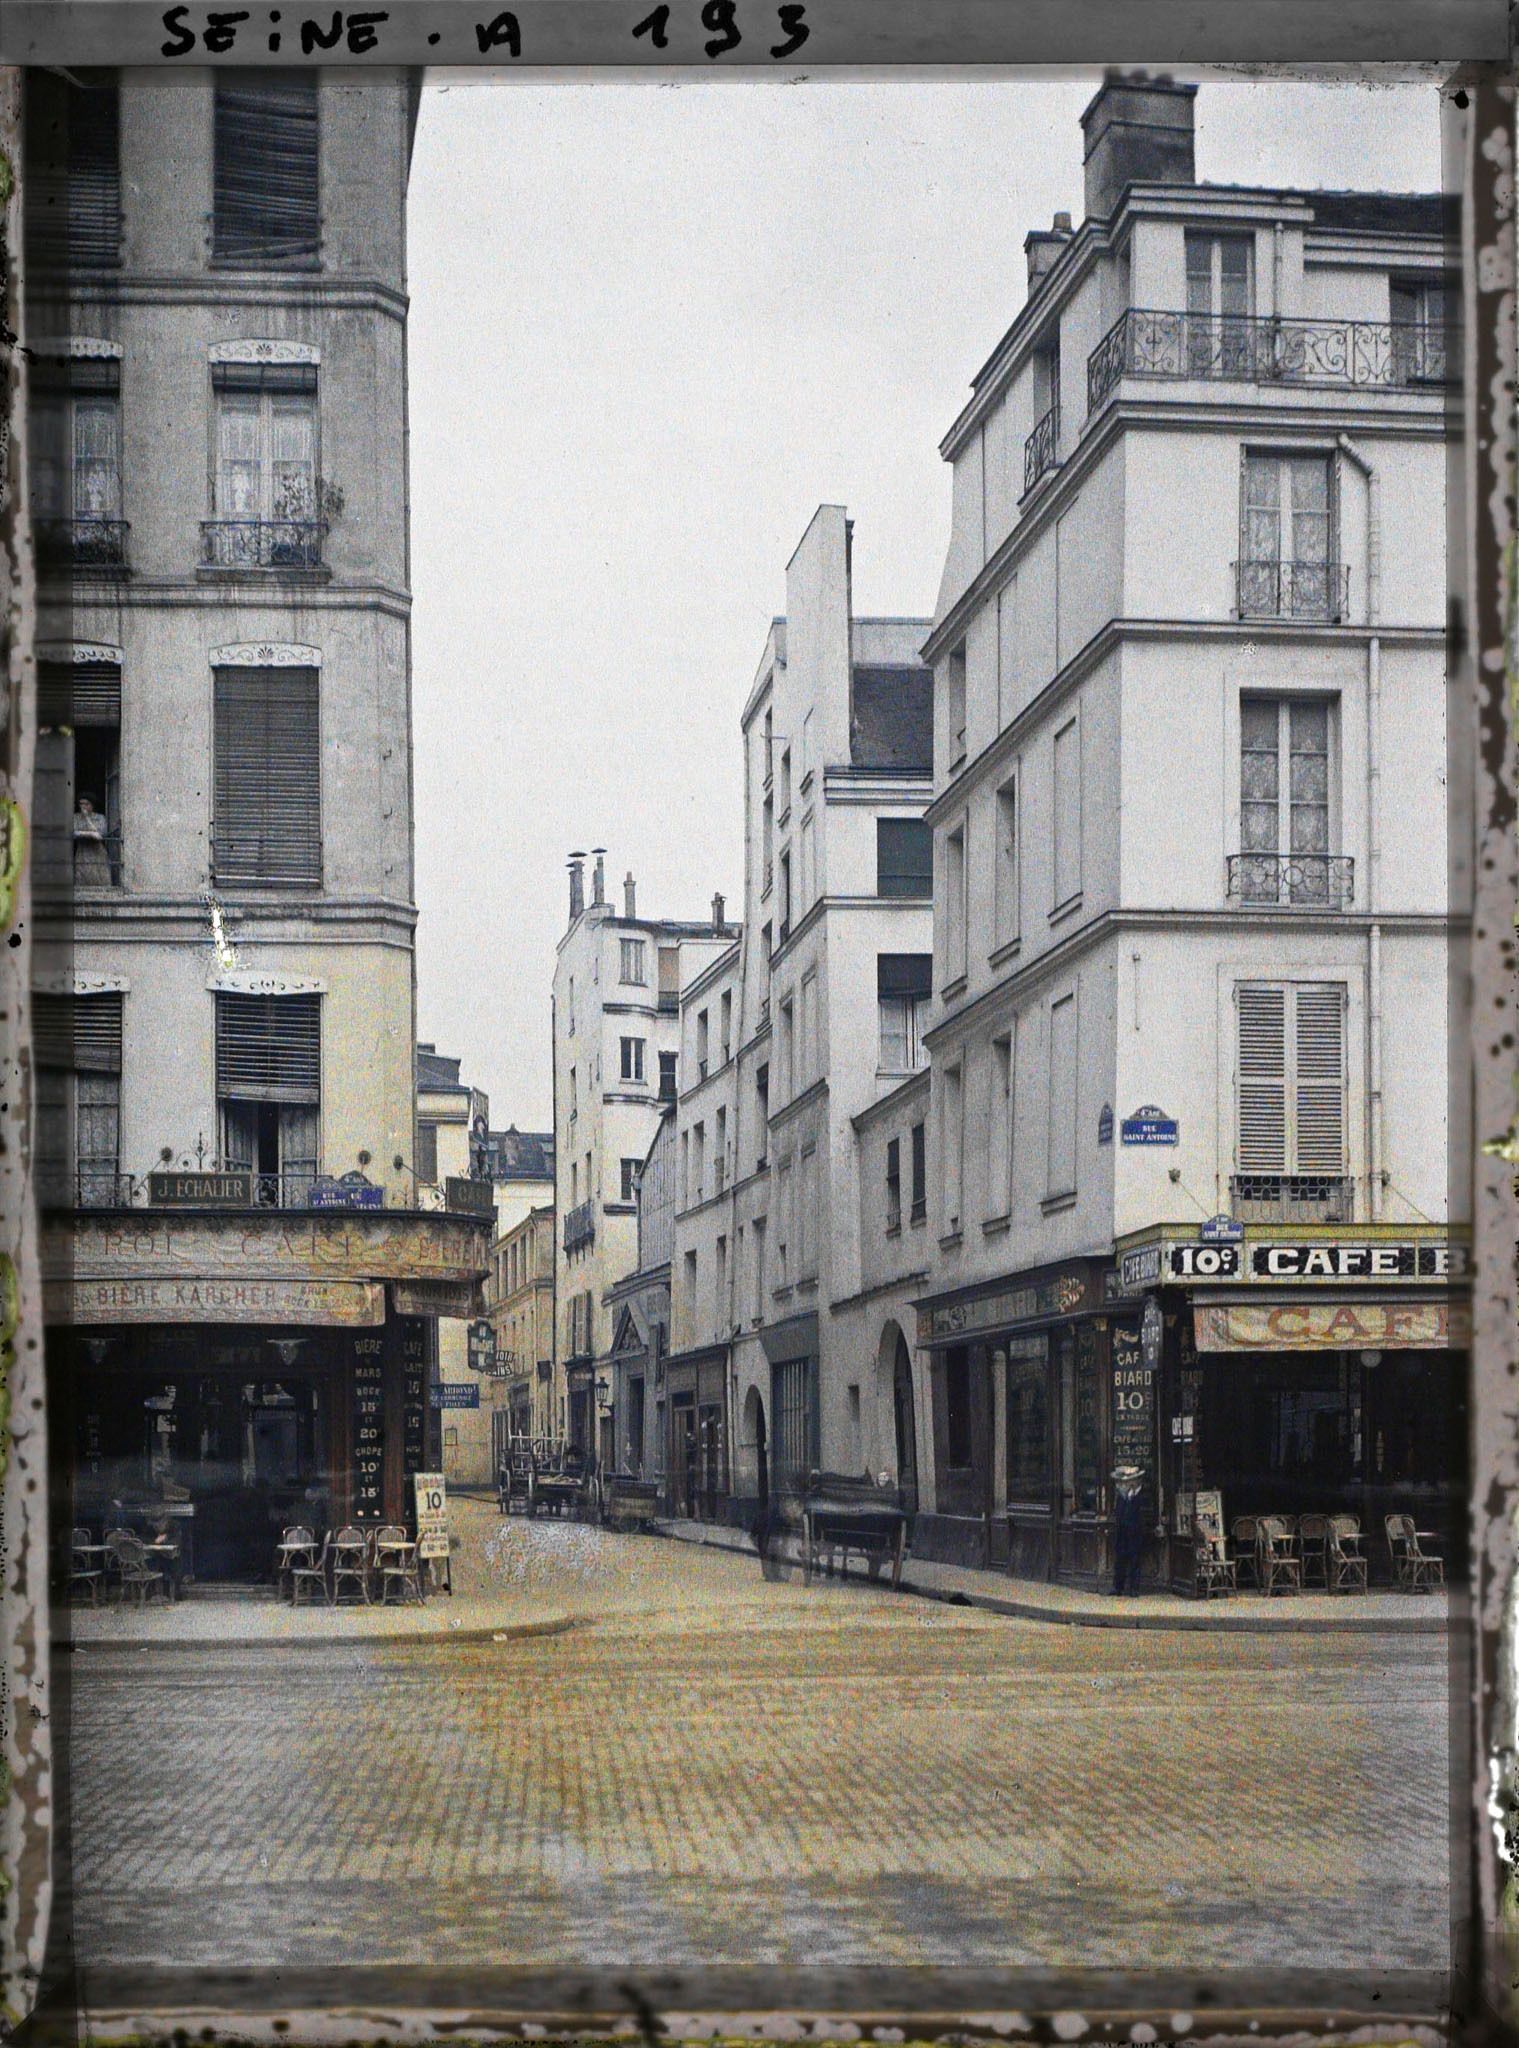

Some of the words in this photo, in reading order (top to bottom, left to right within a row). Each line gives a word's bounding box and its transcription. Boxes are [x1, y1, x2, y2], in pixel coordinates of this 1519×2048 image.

[632, 0, 810, 58] 193
[1123, 1133, 1144, 1141] SAINT
[1146, 1133, 1176, 1141] ANTOINE
[1268, 1248, 1401, 1275] CAFE
[1116, 1352, 1140, 1366] CAF
[1114, 1370, 1152, 1386] BIARD
[426, 1491, 443, 1510] 10
